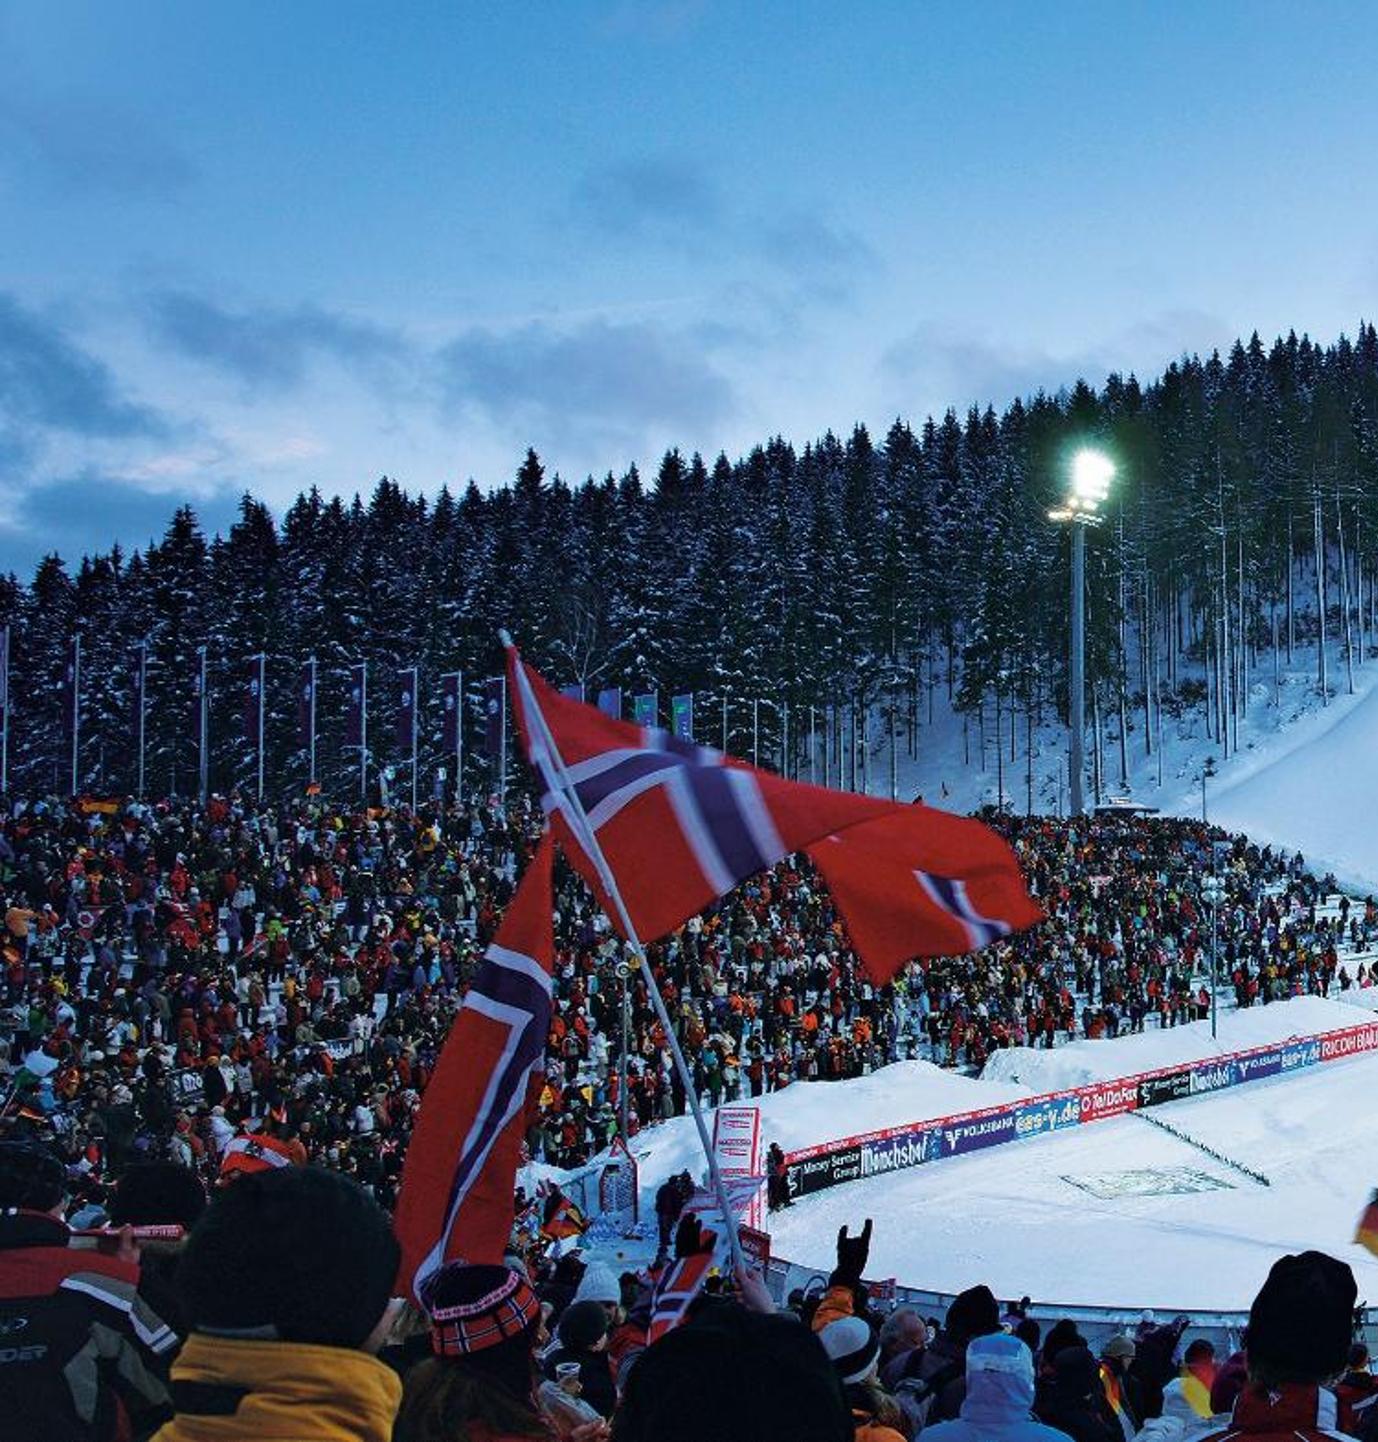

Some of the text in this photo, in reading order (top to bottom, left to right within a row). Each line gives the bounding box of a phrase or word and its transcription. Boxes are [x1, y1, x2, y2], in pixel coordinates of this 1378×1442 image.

[1321, 1033, 1357, 1057] RICOH
[1093, 1087, 1137, 1110] TelDaFax
[804, 1152, 860, 1173] Money Service
[861, 1136, 928, 1176] Mönchshof
[833, 1166, 860, 1180] Group
